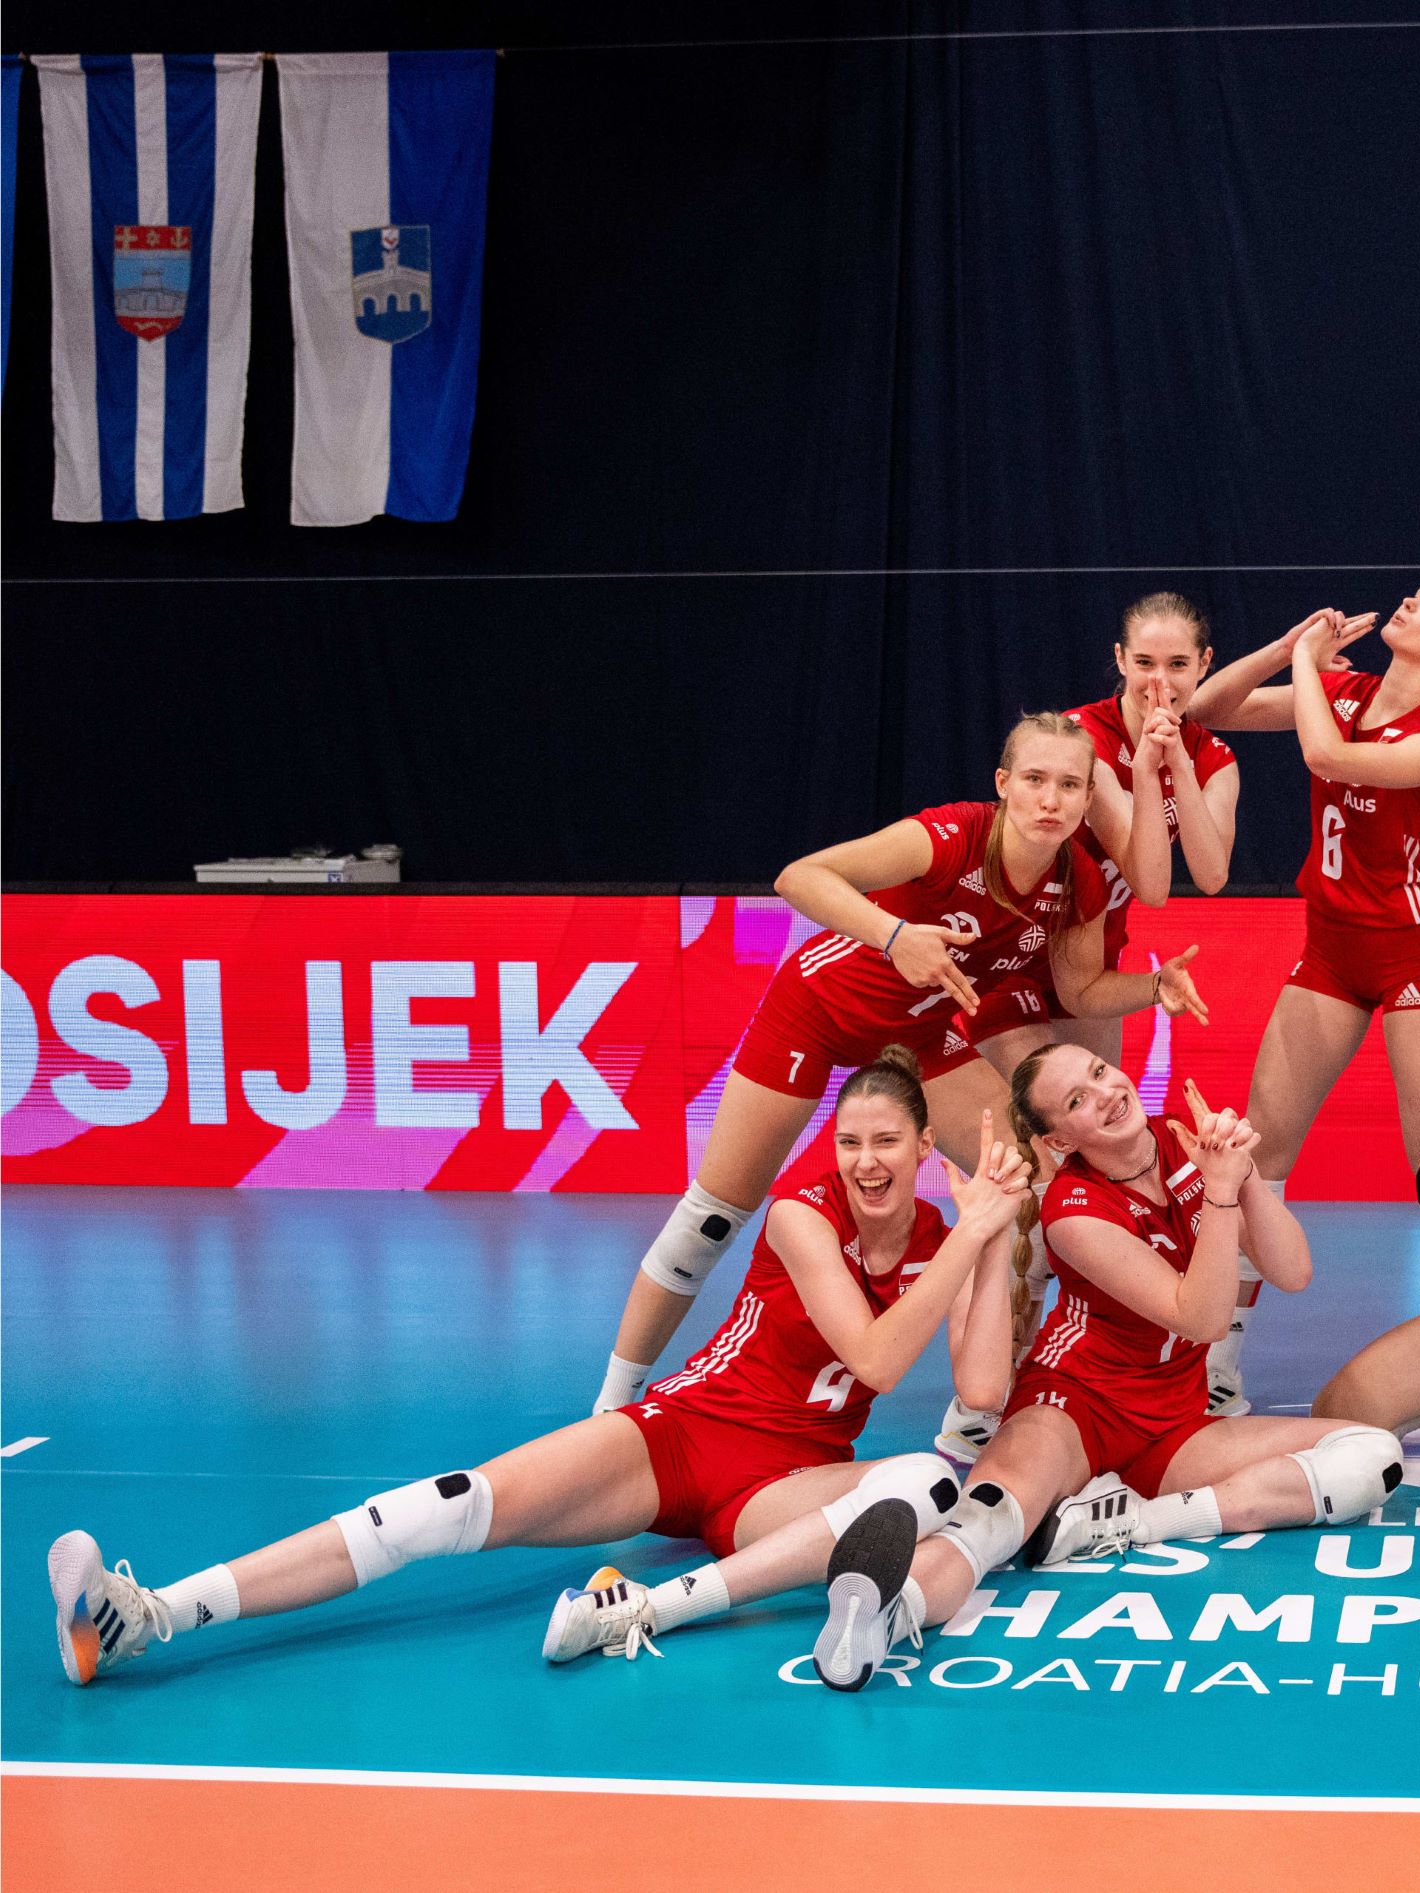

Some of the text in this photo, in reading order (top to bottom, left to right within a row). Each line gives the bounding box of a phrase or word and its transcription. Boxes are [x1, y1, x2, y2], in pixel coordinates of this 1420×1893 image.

[931, 822, 950, 841] plus
[1322, 804, 1345, 880] 6
[958, 877, 987, 896] adidas
[943, 1039, 969, 1056] adidas
[788, 1050, 806, 1083] 7
[798, 1188, 824, 1205] plus
[1178, 1177, 1206, 1205] POLSK
[1062, 1197, 1088, 1206] plus
[806, 1361, 856, 1412] 4
[1035, 1391, 1068, 1410] 14
[638, 1402, 663, 1419] 4
